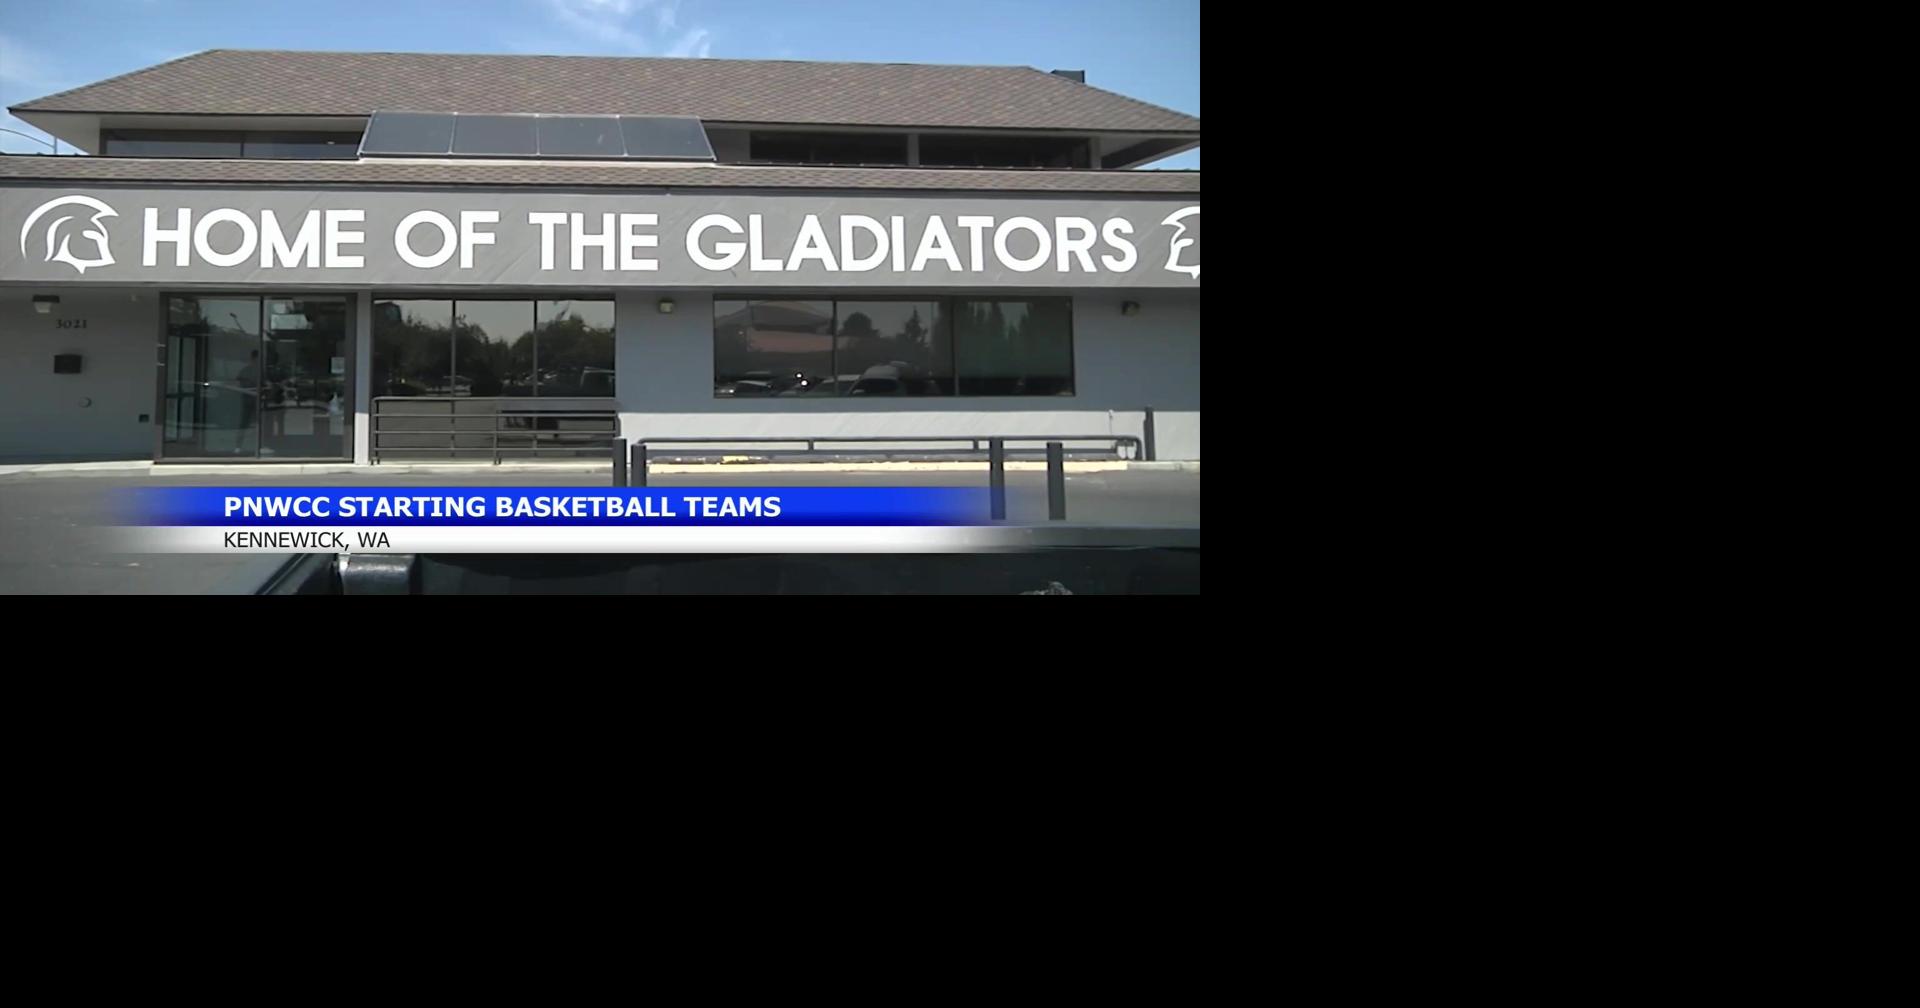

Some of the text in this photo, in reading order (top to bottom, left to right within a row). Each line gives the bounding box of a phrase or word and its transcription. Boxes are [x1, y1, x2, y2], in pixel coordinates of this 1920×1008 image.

[142, 207, 1138, 273] HOME OF THE GLADIATORS
[56, 319, 88, 329] 3021
